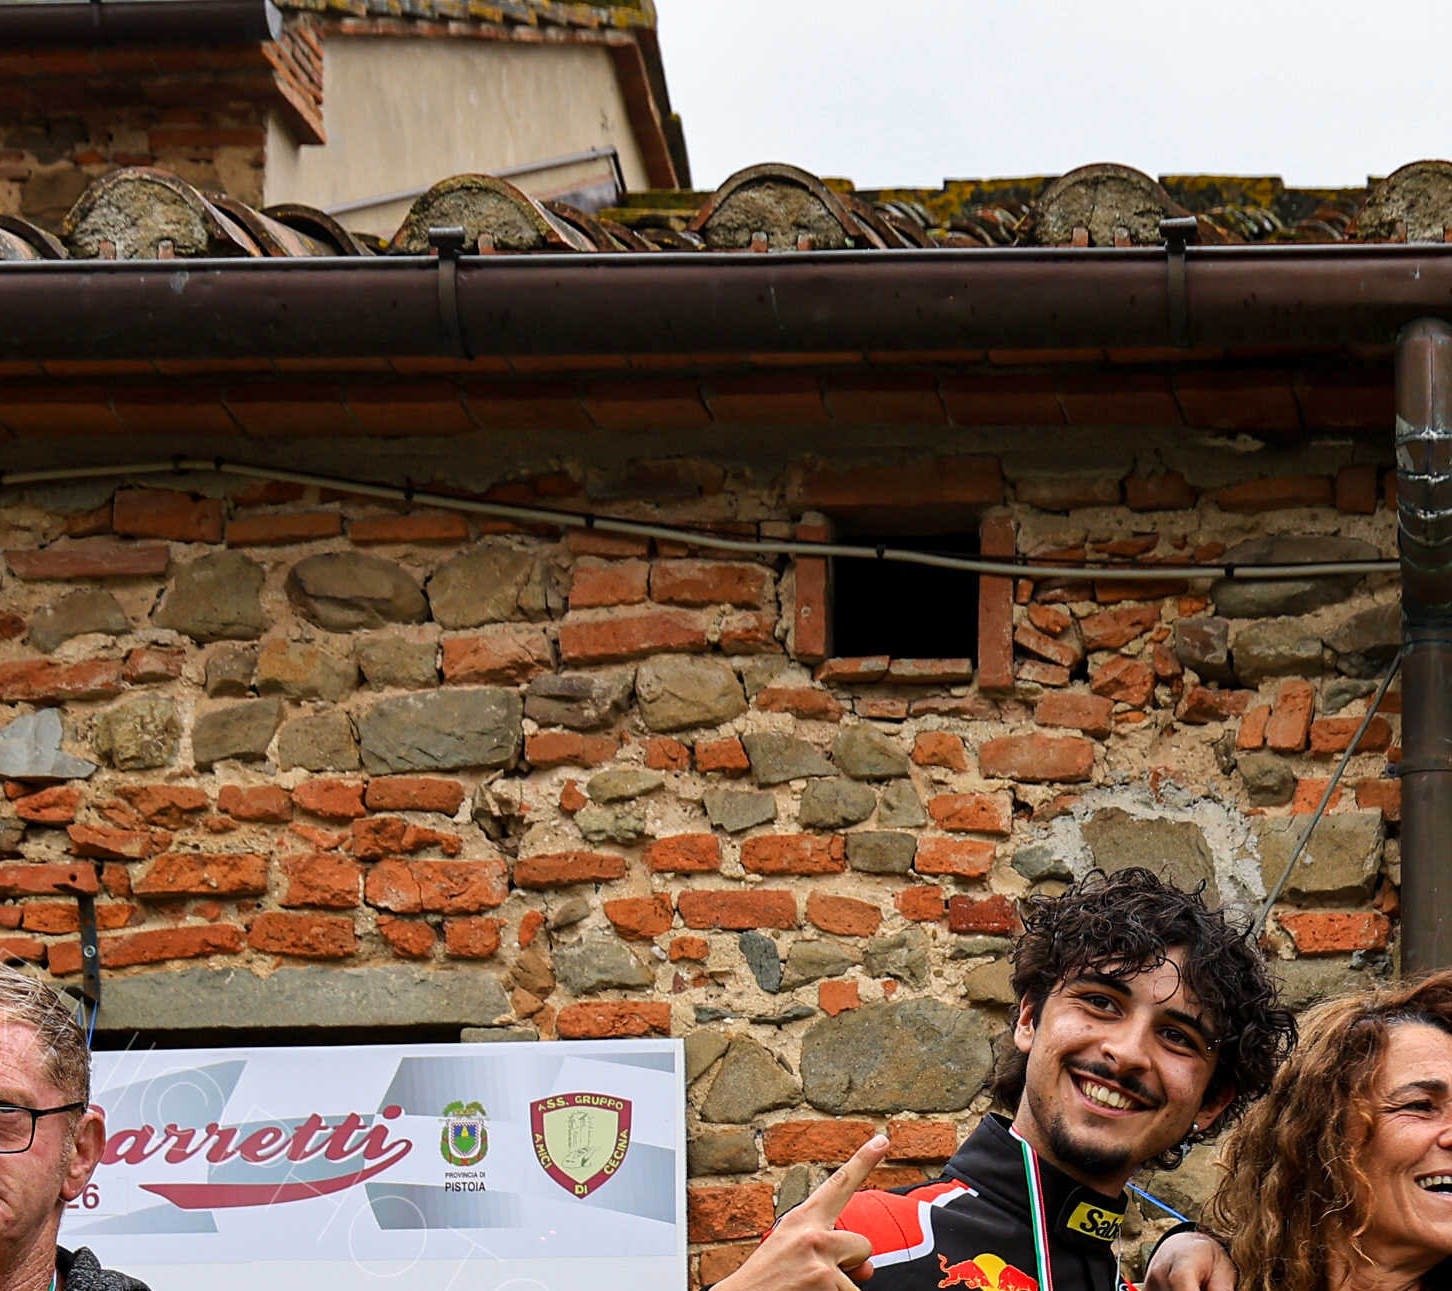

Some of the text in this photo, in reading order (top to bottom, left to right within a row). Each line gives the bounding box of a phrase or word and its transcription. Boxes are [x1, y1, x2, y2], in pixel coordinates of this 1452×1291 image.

[538, 1096, 623, 1111] ASS. GRUPPO
[535, 1129, 628, 1194] AMICI DI CECINA
[445, 1182, 486, 1192] PISTOIA
